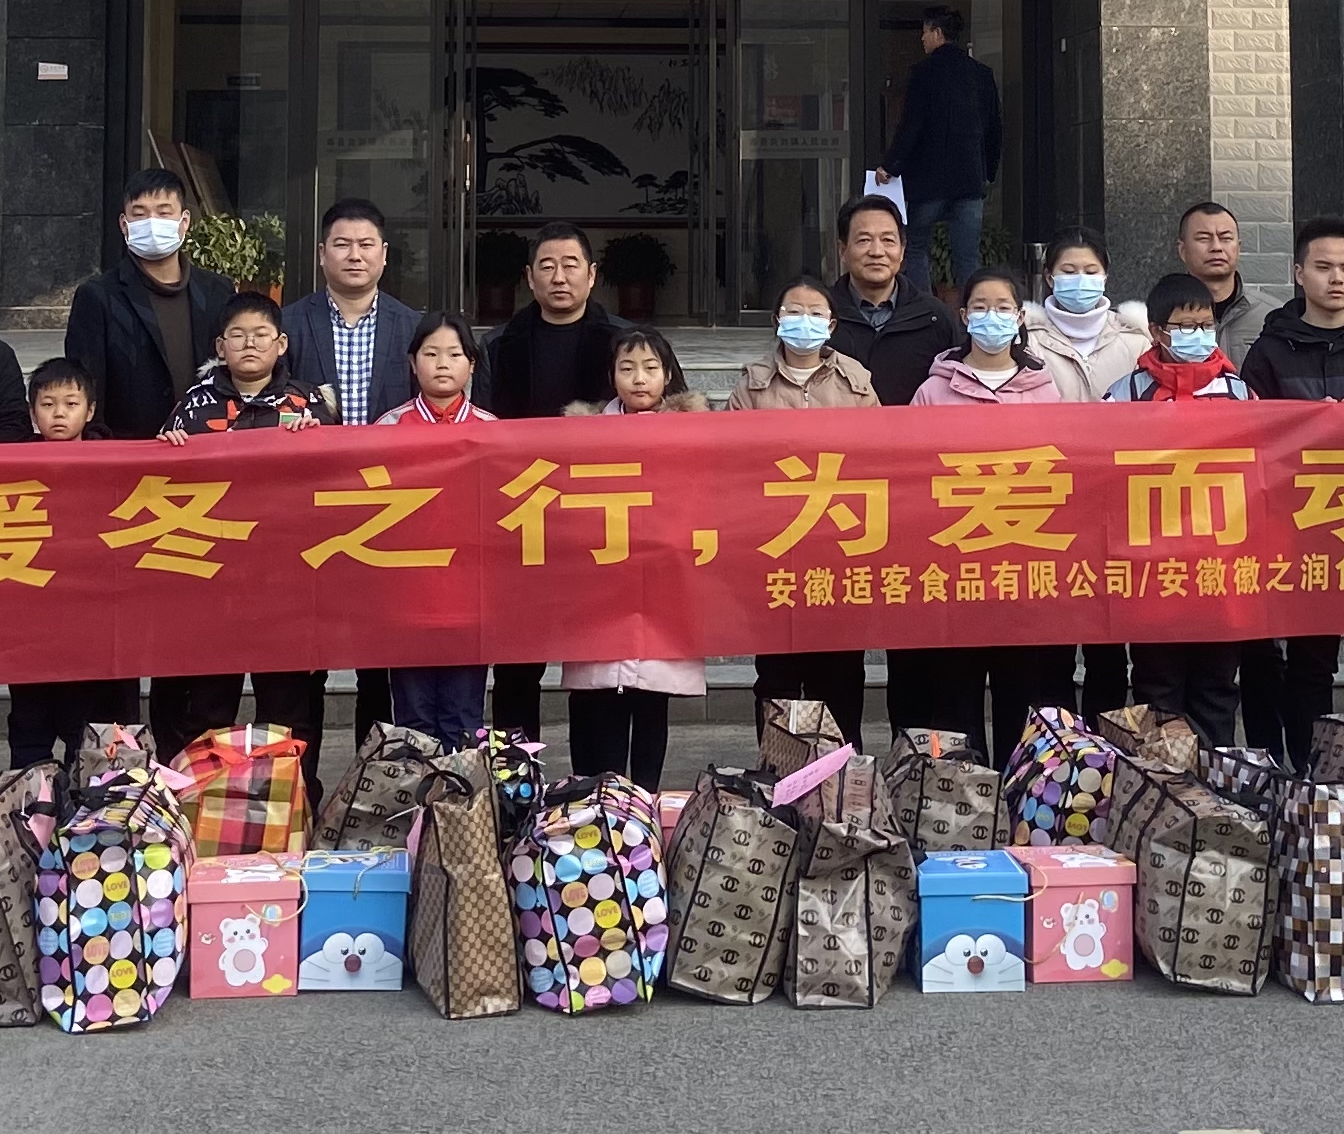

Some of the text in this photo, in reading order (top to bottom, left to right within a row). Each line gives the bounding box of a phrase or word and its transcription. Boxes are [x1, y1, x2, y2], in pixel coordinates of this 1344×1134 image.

[576, 829, 599, 840] LOVE
[105, 880, 129, 892] LOVE
[596, 907, 619, 919] LOVE
[111, 966, 134, 978] LOVE
